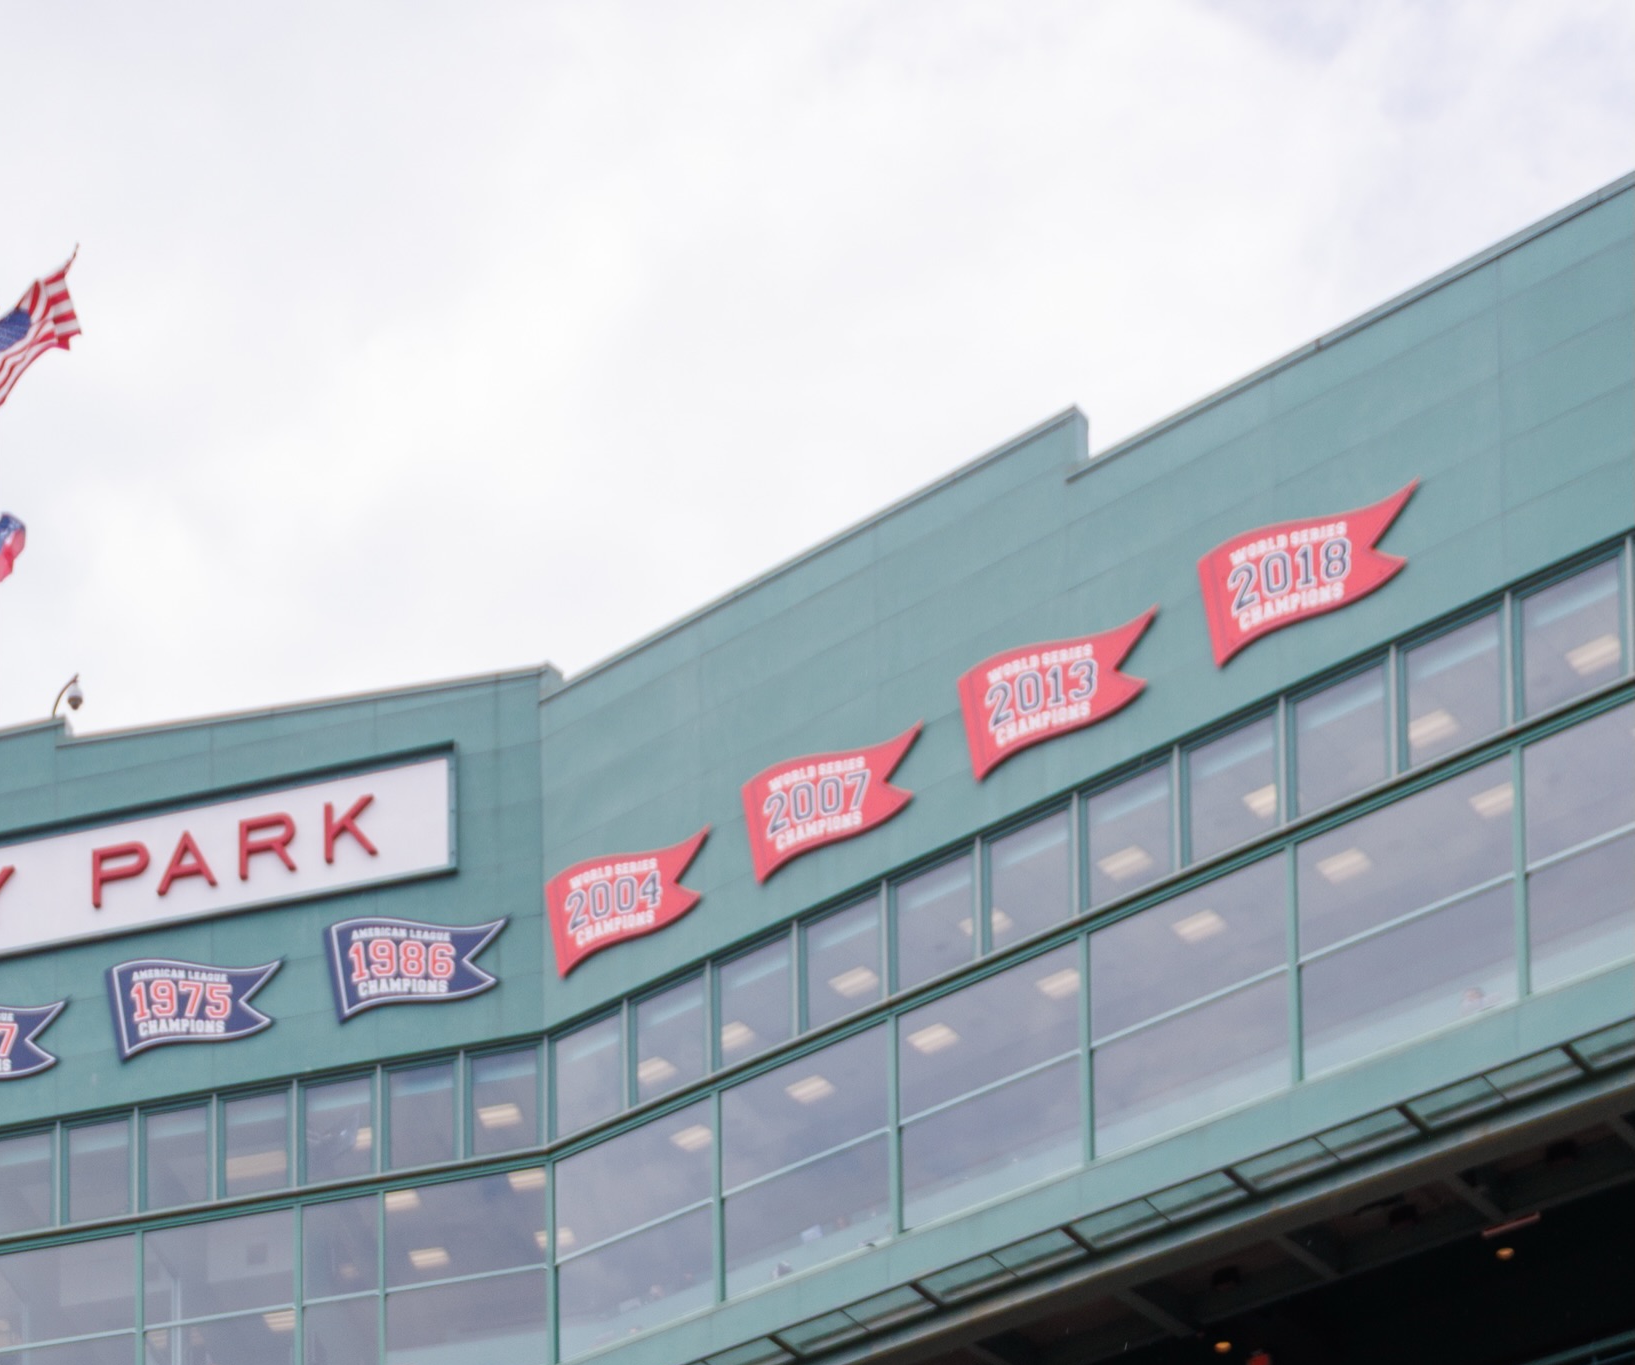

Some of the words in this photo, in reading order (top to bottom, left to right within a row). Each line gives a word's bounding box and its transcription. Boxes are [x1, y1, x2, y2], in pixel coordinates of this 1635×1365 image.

[1229, 533, 1285, 564] WORLD
[1289, 521, 1347, 546] SERIES
[1227, 535, 1352, 611] 2018
[1236, 580, 1345, 633] CHAMPIONS
[987, 656, 1037, 683] WORLD
[1041, 643, 1094, 667] SERIES
[985, 658, 1098, 731] 2013
[995, 700, 1092, 746] CHAMPIONS
[768, 766, 815, 791] WORLD
[818, 756, 866, 777] SERIES
[764, 769, 871, 839] 2007
[90, 794, 379, 909] PARK
[775, 810, 863, 852] CHAMPIONS
[568, 866, 613, 891] WORLD
[615, 858, 658, 878] SERIES
[564, 870, 662, 937] 2004
[349, 926, 405, 941] AMERICAN
[408, 927, 451, 943] LEAGUE
[575, 912, 656, 947] CHAMPIONS
[130, 967, 184, 983] AMERICAN
[187, 967, 228, 983] LEAGUE
[347, 940, 456, 980] 1986
[129, 980, 233, 1021] 1975
[356, 977, 449, 998] CHAMPIONS
[136, 1016, 226, 1037] CHAMPIONS
